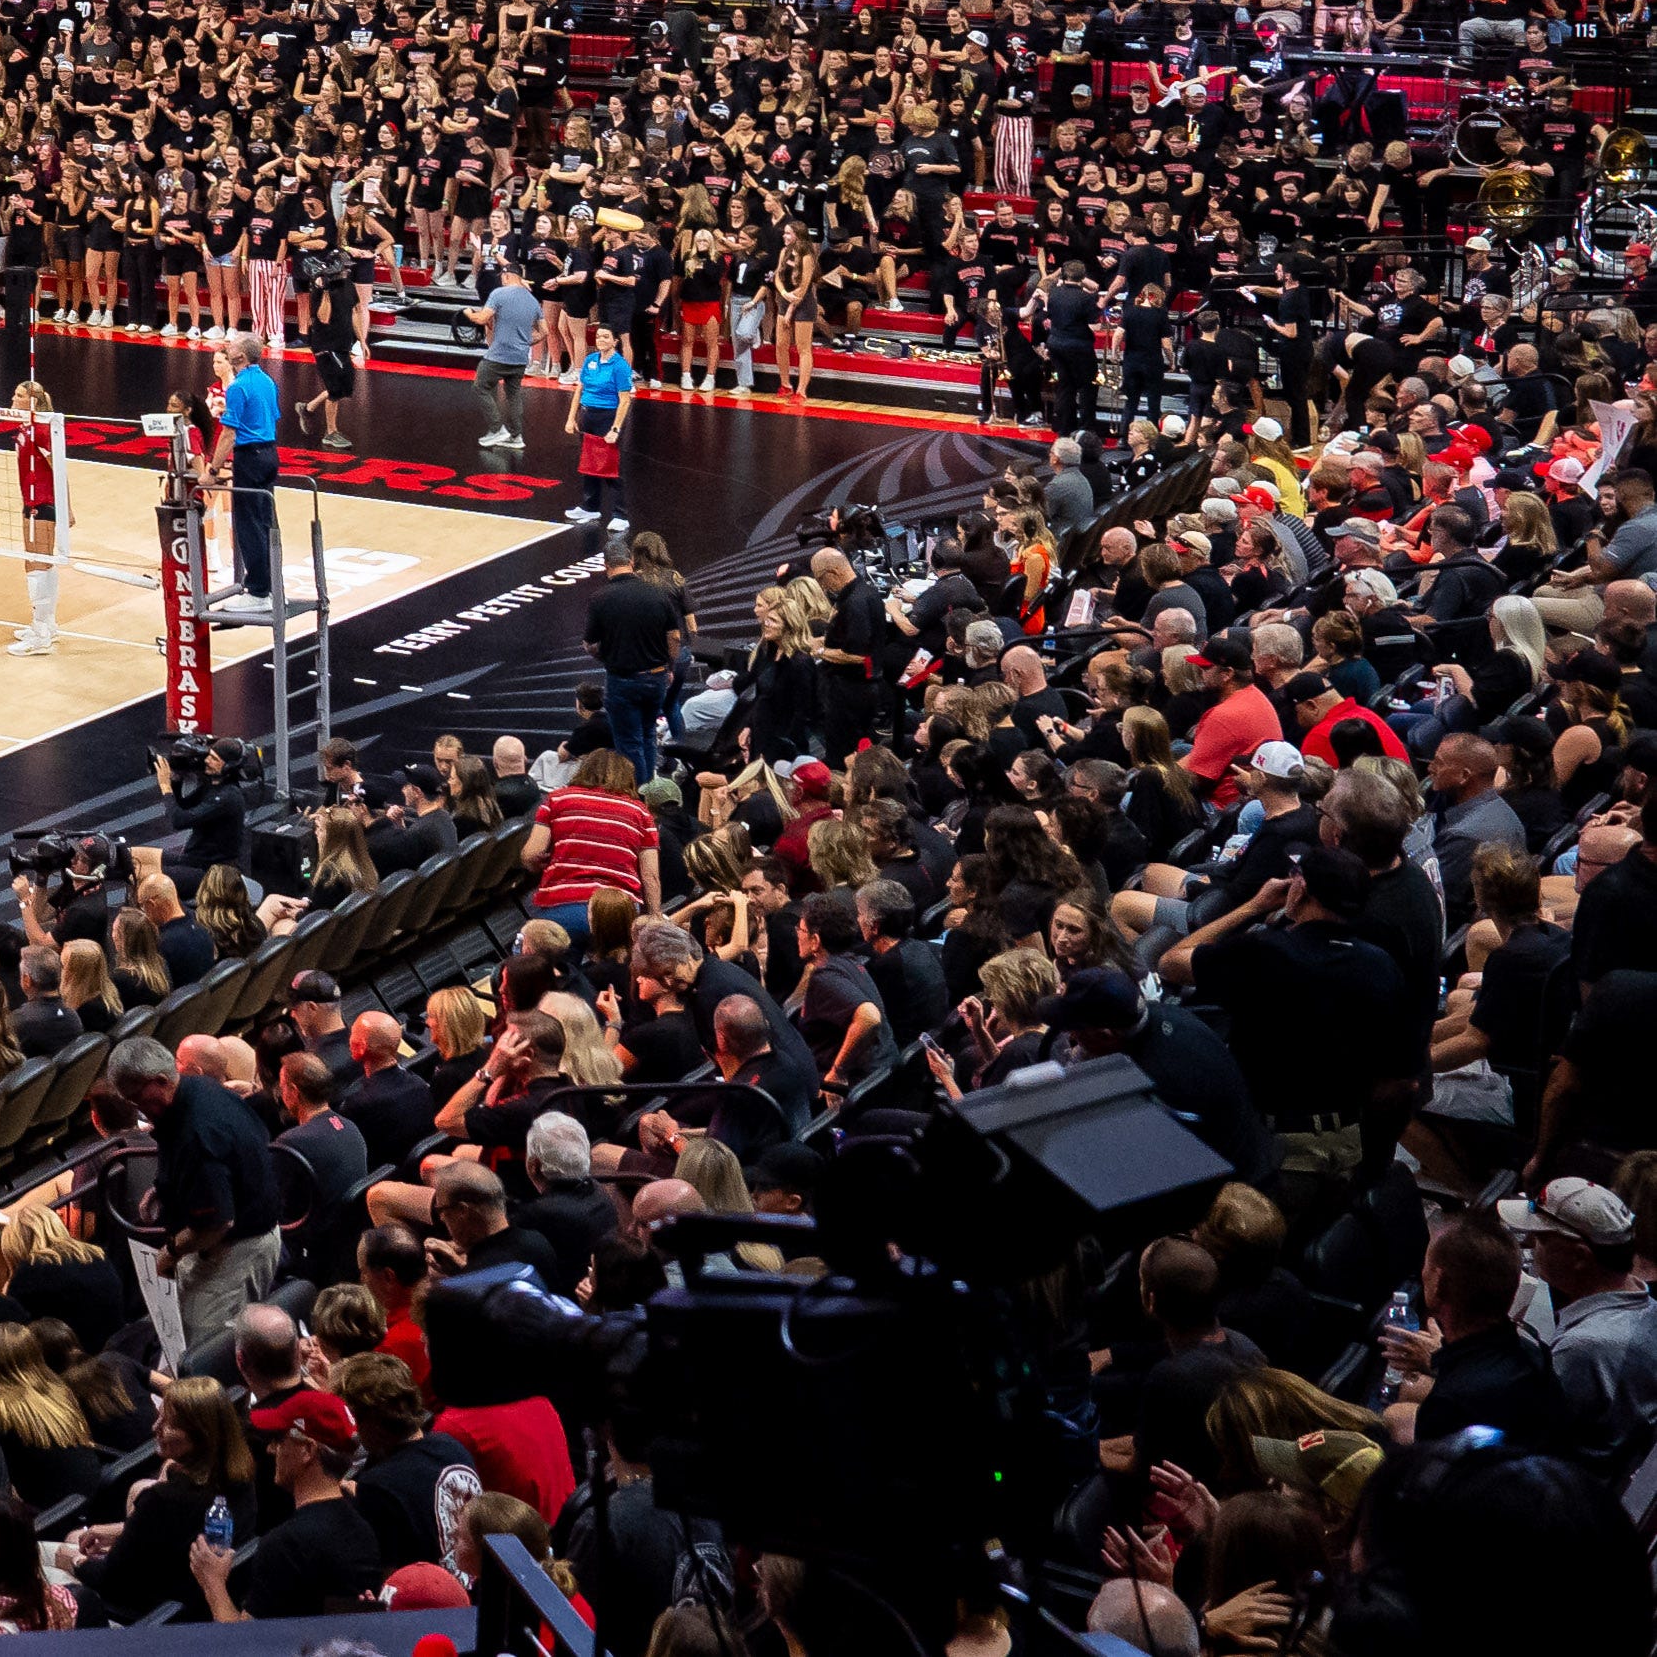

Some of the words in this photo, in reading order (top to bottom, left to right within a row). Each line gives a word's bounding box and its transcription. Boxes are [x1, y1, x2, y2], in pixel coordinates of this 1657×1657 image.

[1575, 24, 1596, 38] 115
[373, 620, 470, 654] TERRY
[456, 584, 553, 621] PETTIT
